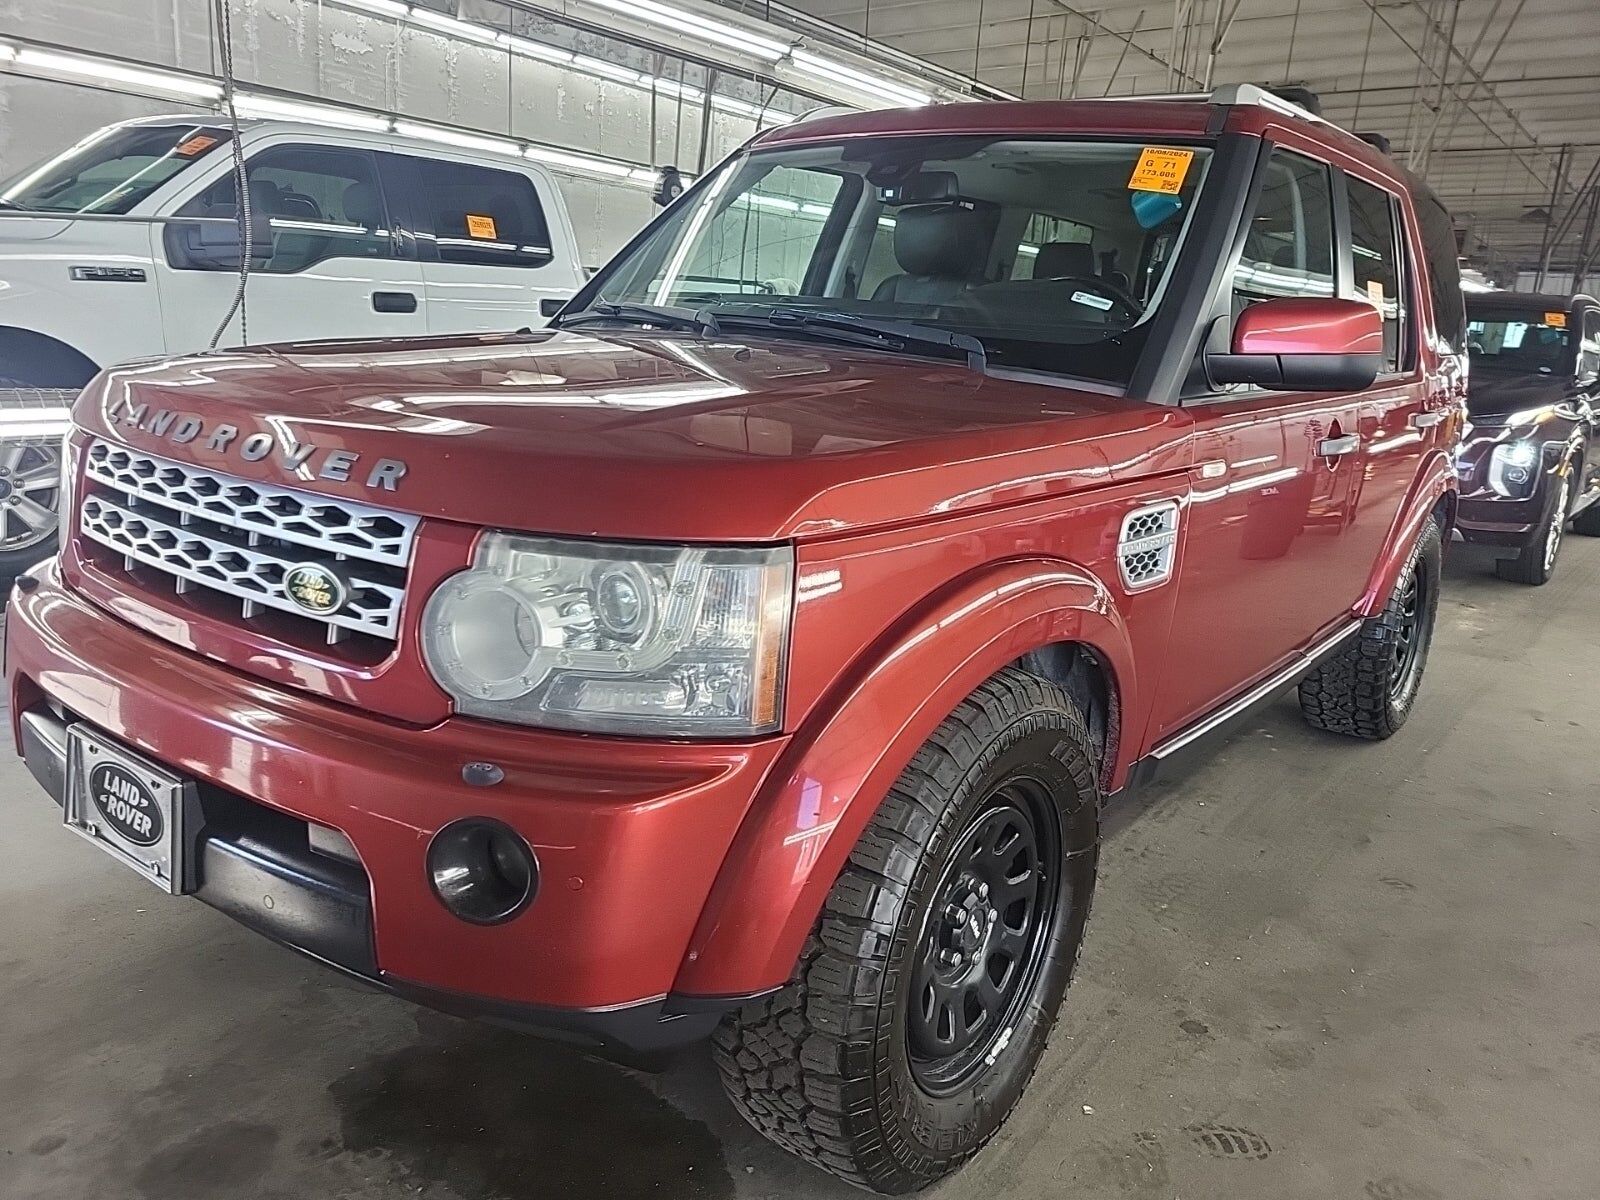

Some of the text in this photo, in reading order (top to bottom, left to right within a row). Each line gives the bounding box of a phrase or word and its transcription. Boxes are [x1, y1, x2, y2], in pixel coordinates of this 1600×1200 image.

[1145, 159, 1177, 169] G 71
[103, 770, 141, 807] LAND
[1049, 739, 1093, 806] KENDA
[106, 797, 153, 838] ROVER
